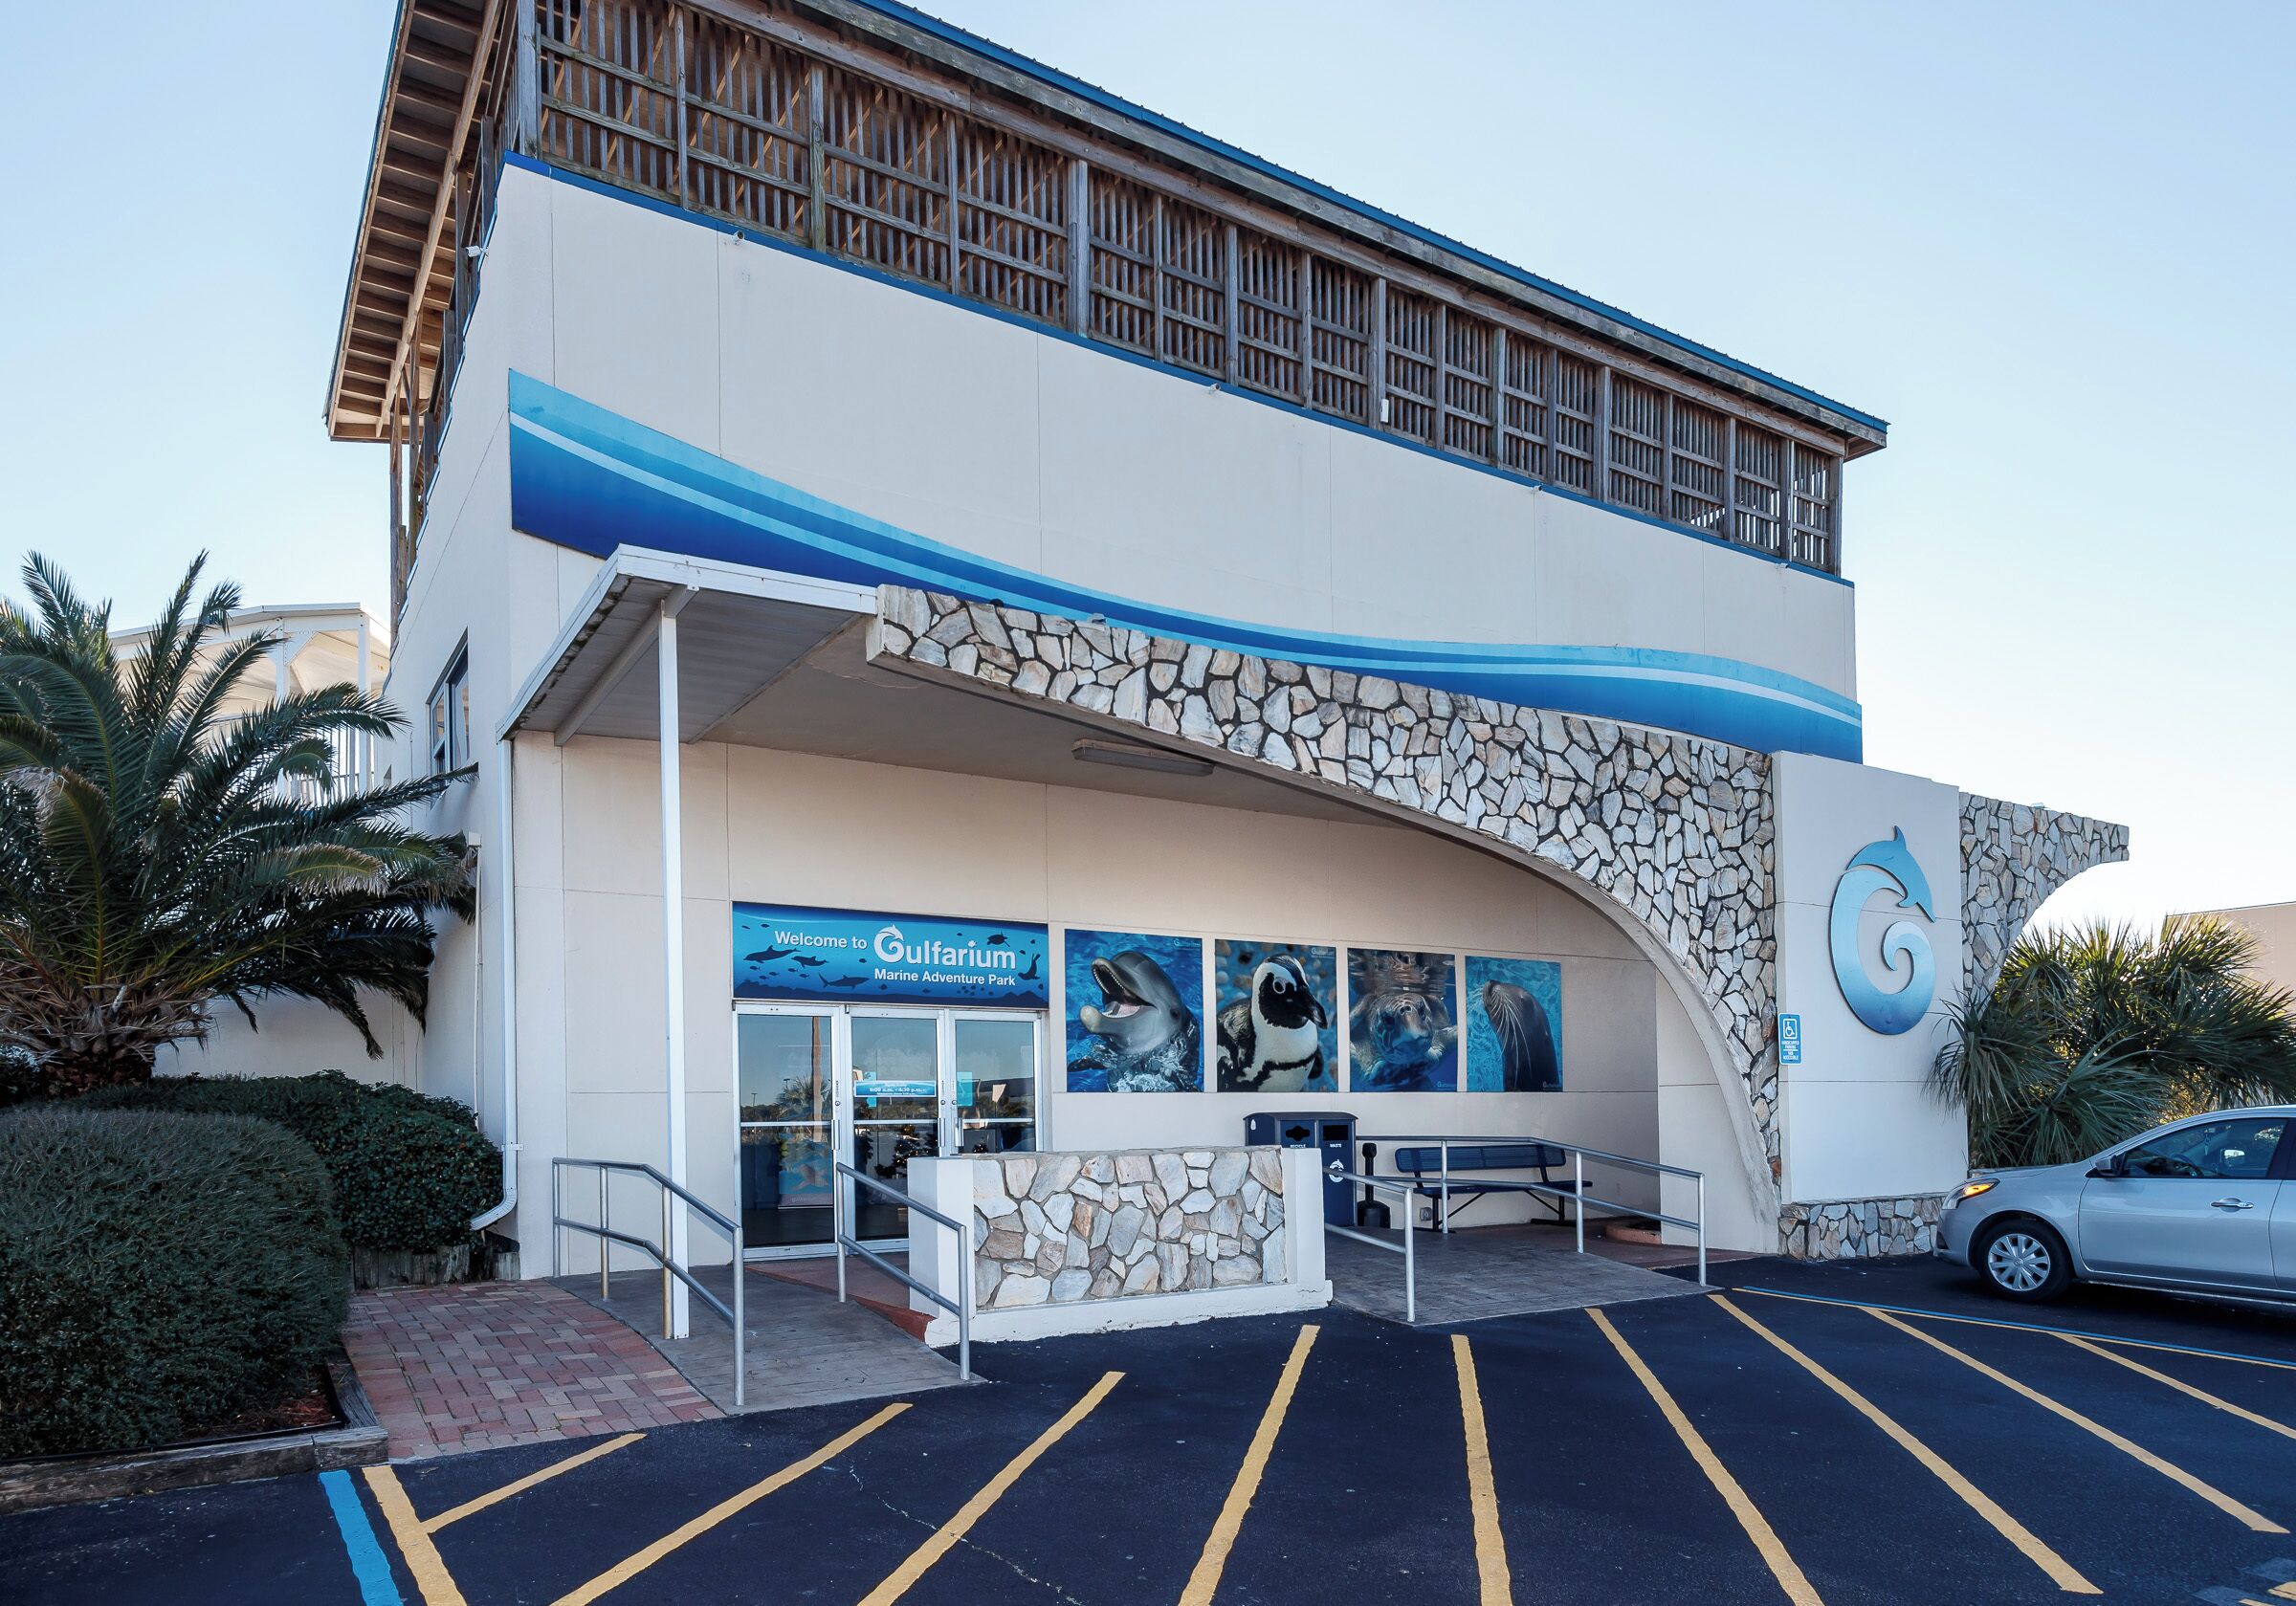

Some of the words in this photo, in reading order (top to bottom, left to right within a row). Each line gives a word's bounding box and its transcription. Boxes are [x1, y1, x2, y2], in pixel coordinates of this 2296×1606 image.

[774, 931, 848, 948] Welcome
[851, 936, 868, 950] to
[873, 924, 1016, 969] Gulfarium
[874, 968, 919, 981] Marine
[922, 971, 985, 985] Adventure
[988, 974, 1016, 986] Park
